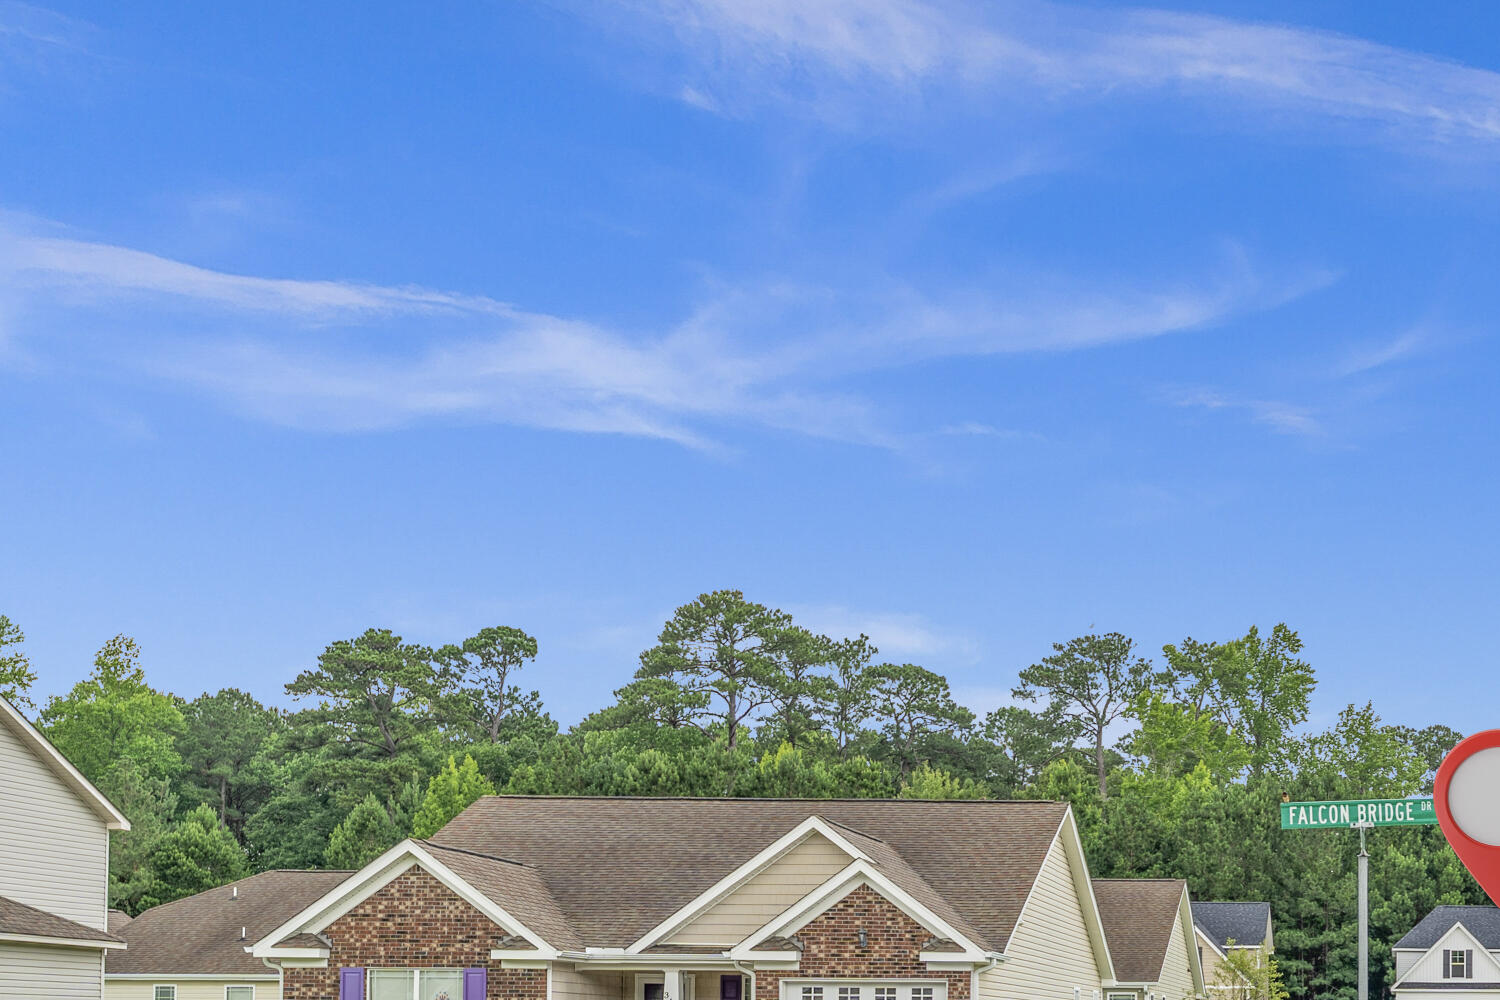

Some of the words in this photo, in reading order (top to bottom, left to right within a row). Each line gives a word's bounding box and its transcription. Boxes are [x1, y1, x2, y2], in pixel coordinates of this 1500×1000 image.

[1289, 804, 1350, 825] FALCON
[1357, 802, 1415, 823] BRIDGE
[1420, 801, 1432, 811] DR
